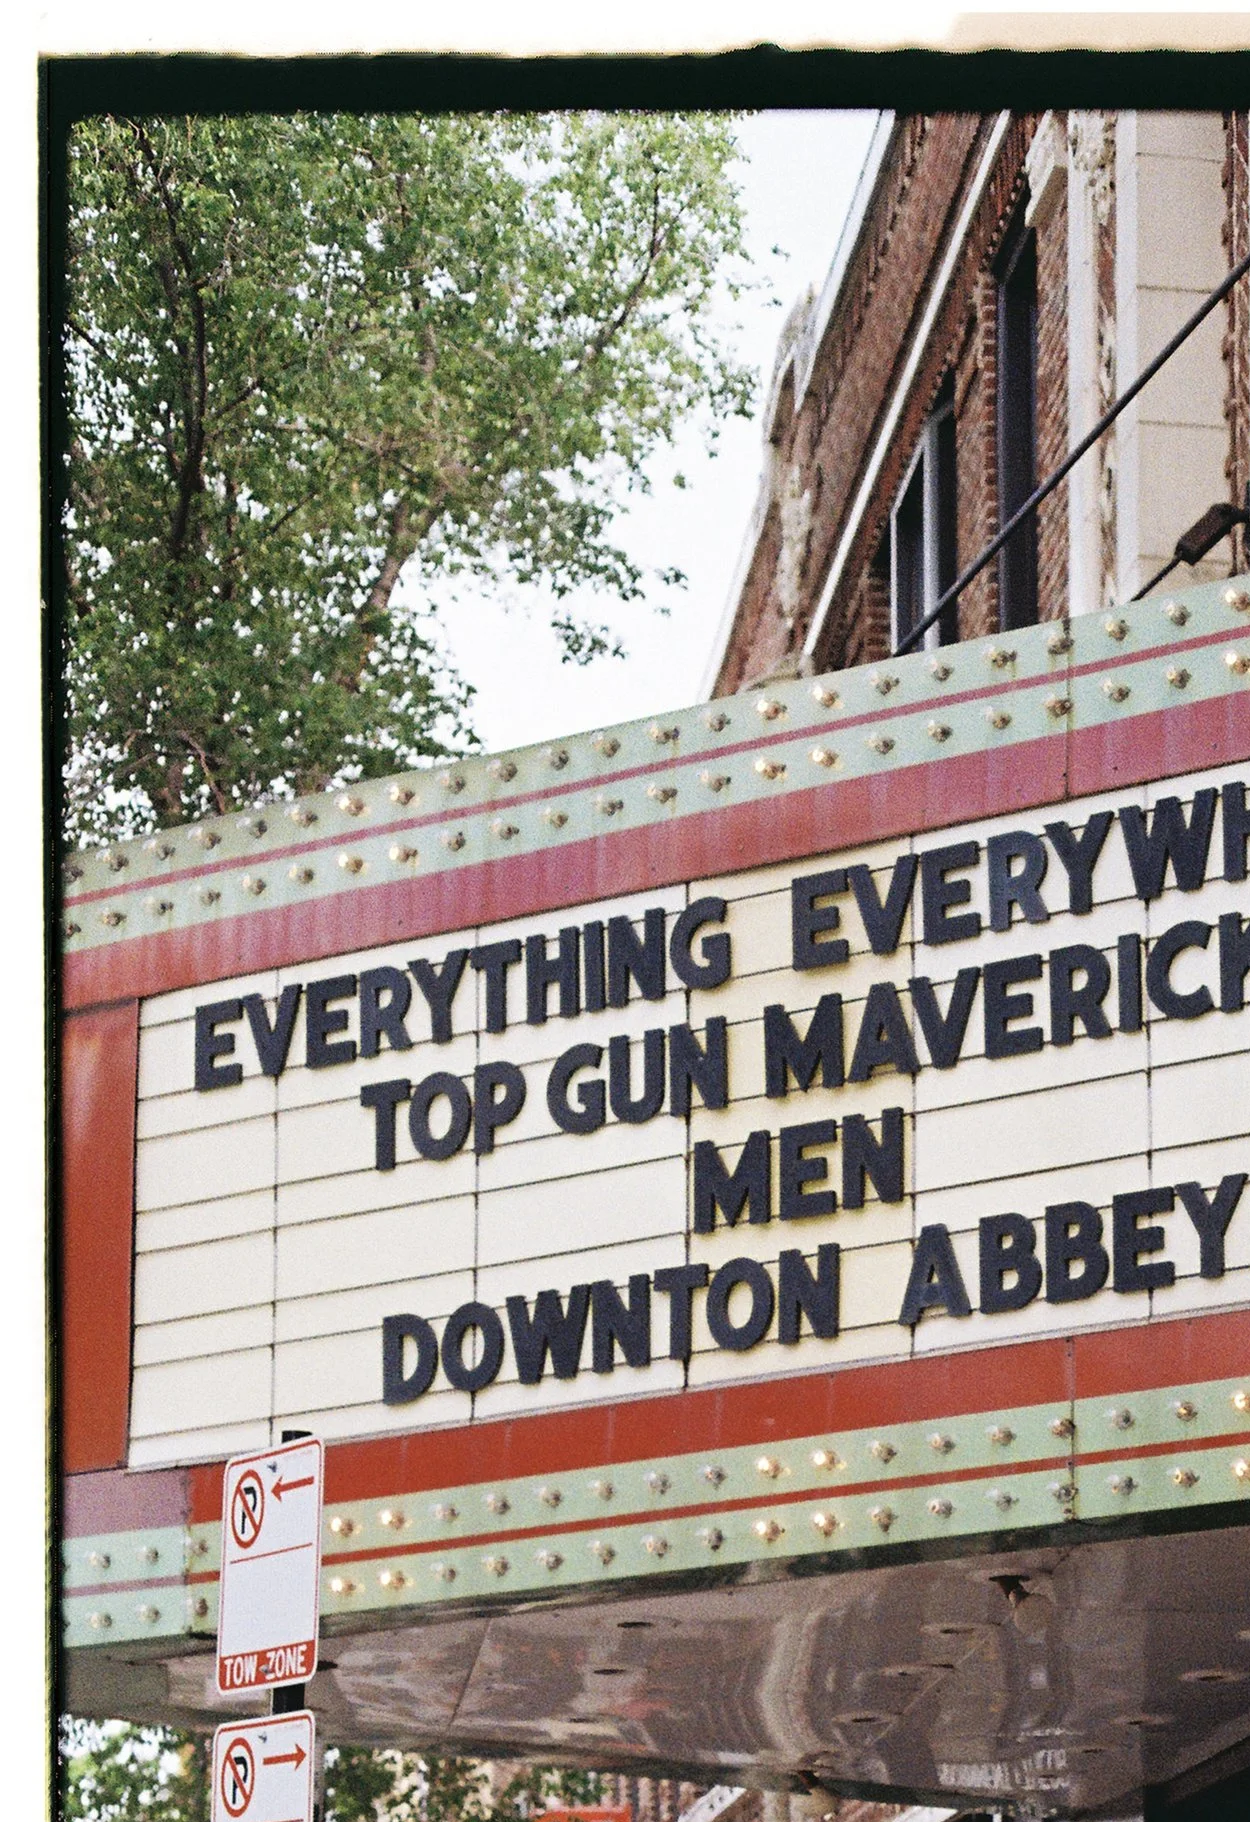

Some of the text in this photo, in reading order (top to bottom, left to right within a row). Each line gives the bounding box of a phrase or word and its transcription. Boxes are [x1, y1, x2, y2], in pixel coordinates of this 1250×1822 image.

[194, 895, 733, 1092] EVERYTHING
[361, 1061, 528, 1172] TOP
[547, 1015, 728, 1136] GUN
[694, 1106, 905, 1235] MEN
[382, 1242, 841, 1406] DOWNTON
[898, 1172, 1249, 1327] ABBEY
